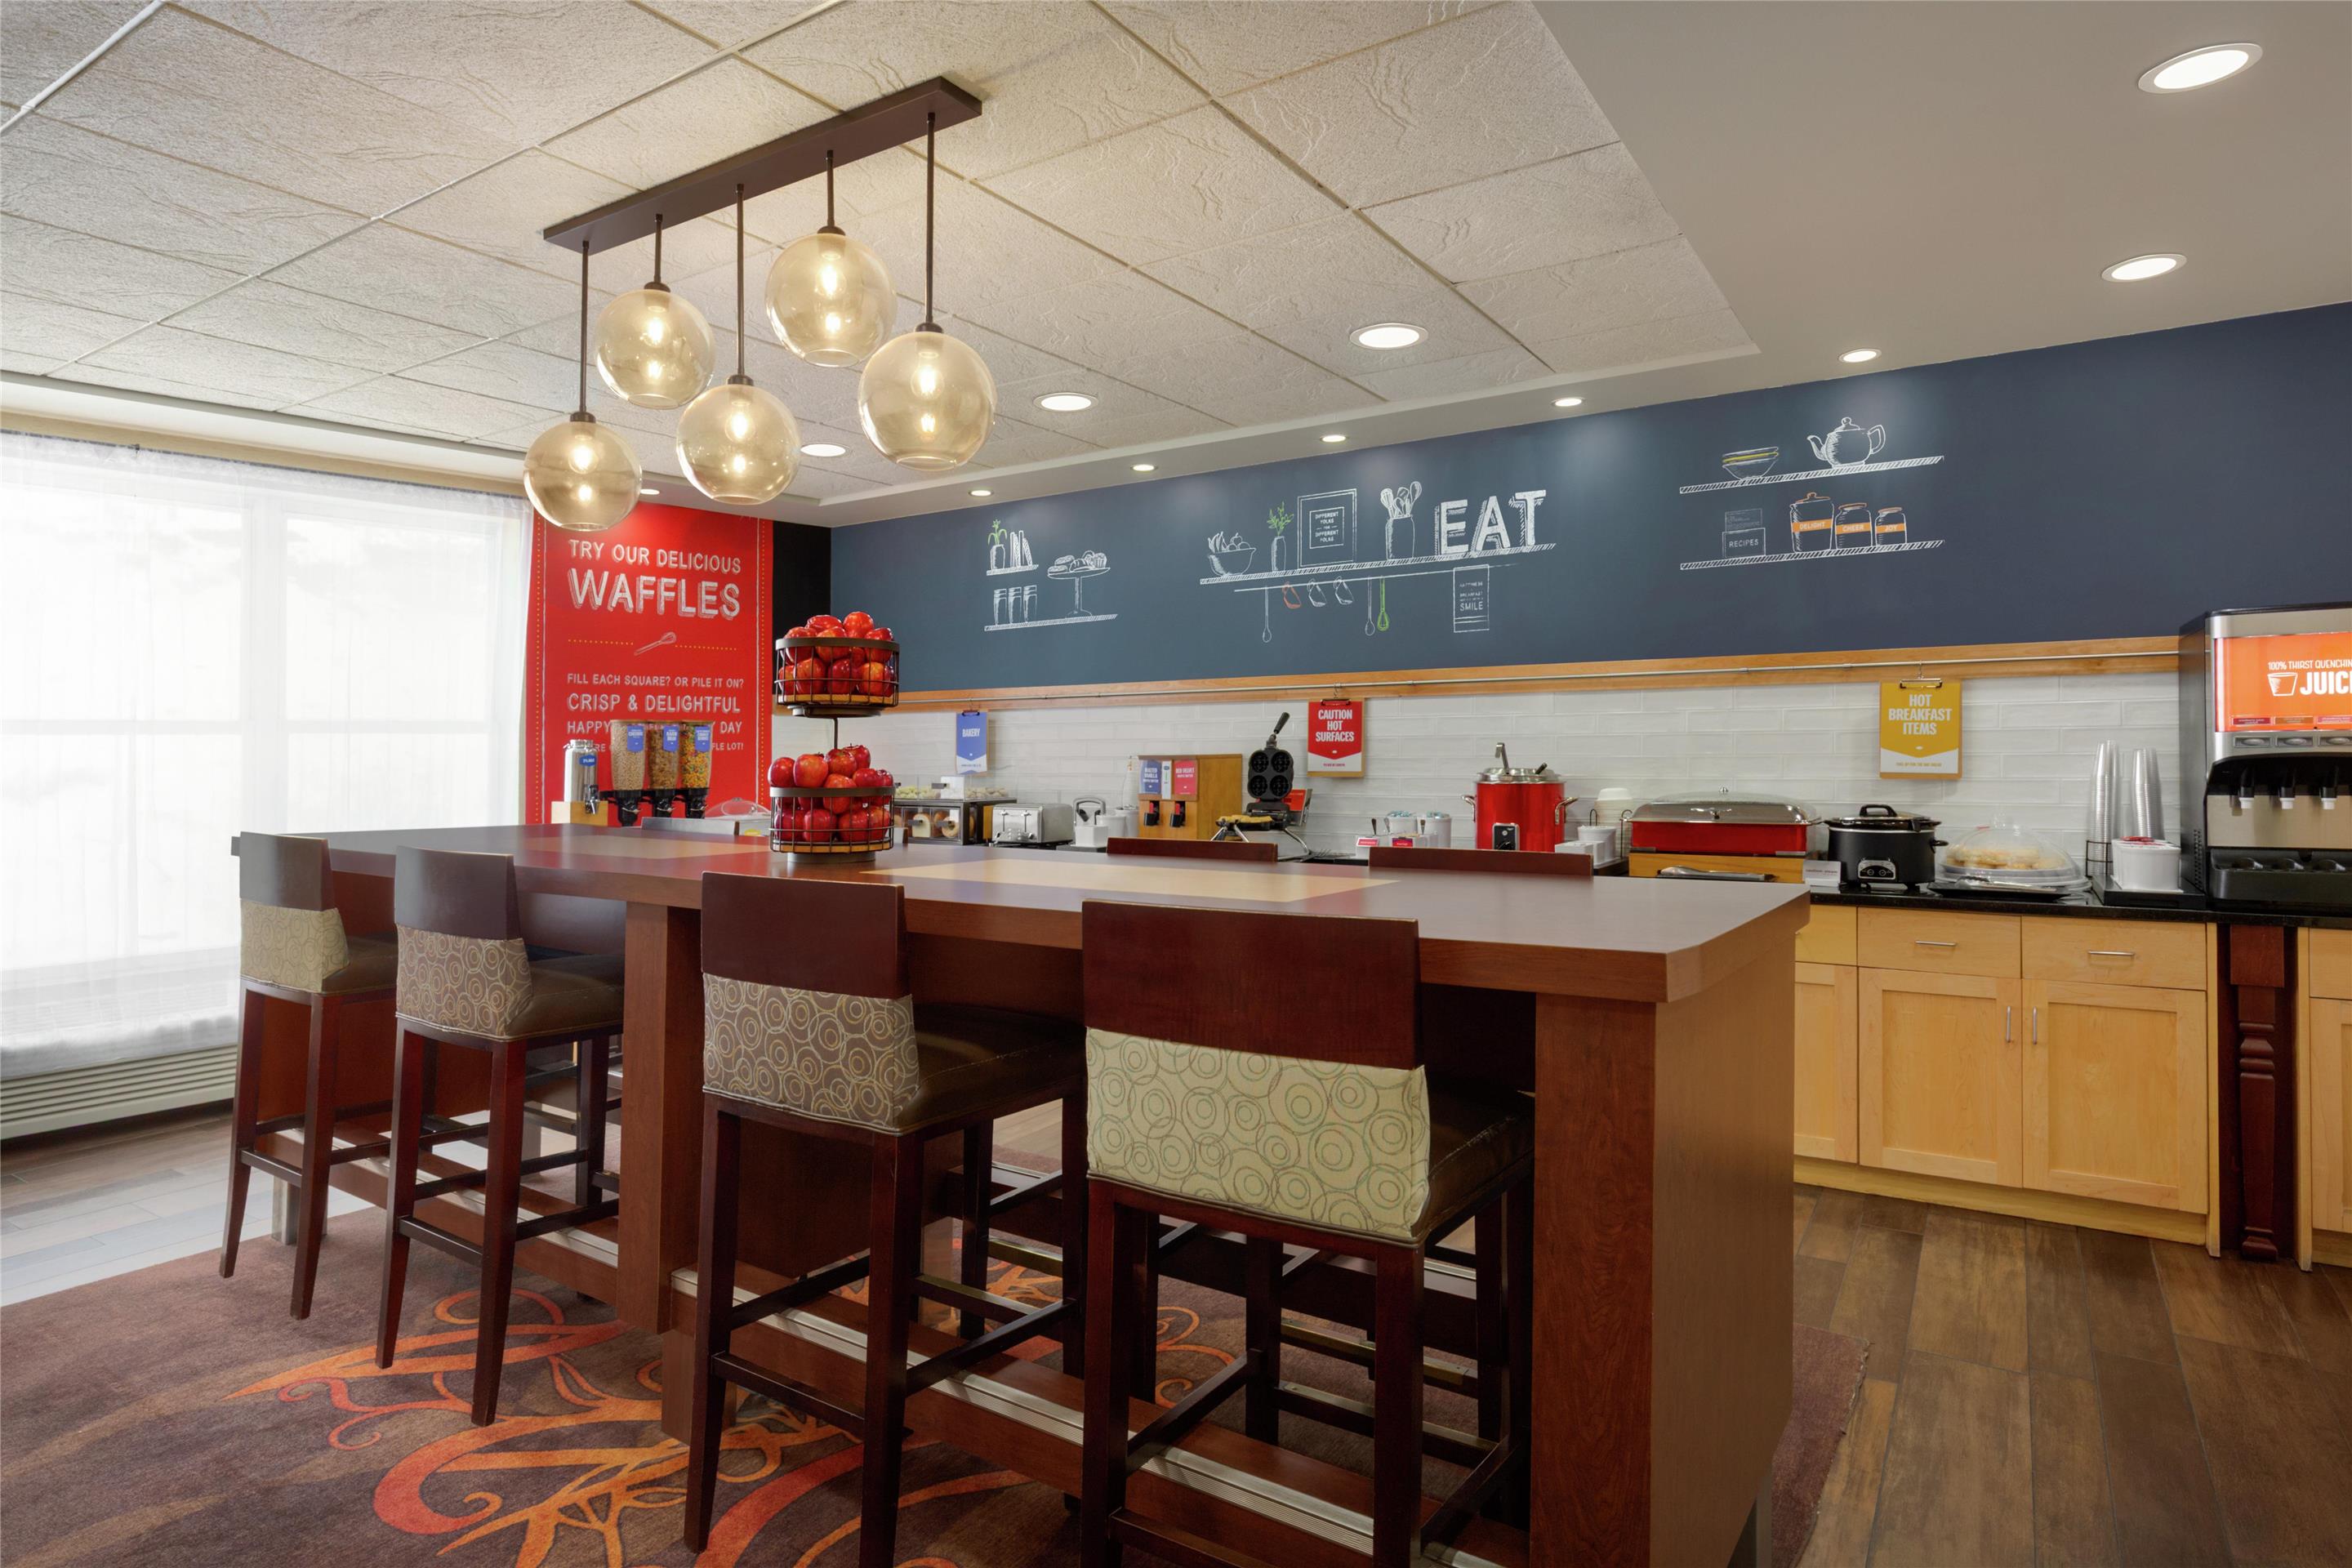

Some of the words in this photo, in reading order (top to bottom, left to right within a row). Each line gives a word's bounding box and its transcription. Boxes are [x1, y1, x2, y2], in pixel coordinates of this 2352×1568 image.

[1435, 490, 1546, 555] EAT
[1799, 522, 1825, 530] DELIGHT
[1729, 539, 1759, 548] RECIPES
[568, 539, 604, 560] TRY
[612, 544, 650, 566] OUR
[656, 549, 742, 574] DELICIOUS
[568, 568, 740, 621] WAFFLES
[1459, 601, 1484, 611] SMILE
[2268, 661, 2287, 670] 100%
[2288, 660, 2313, 669] THIRST
[568, 673, 588, 684] FILL
[593, 674, 621, 685] EACH
[624, 675, 671, 686] SQUARE?
[675, 676, 688, 687] OR
[692, 677, 711, 688] PILE
[715, 678, 723, 688] IT
[726, 678, 744, 688] ON?
[2300, 670, 2352, 695] JUIC
[568, 693, 621, 712] CRISP
[627, 694, 638, 712] &
[645, 694, 741, 714] DELIGHTFUL
[1909, 694, 1932, 706] HOT
[1318, 709, 1353, 719] CAUTION
[1888, 708, 1952, 720] BREAKFAST
[567, 720, 611, 734] HAPPY
[720, 721, 742, 734] DAY
[1327, 720, 1343, 731] HOT
[1903, 722, 1937, 735] ITEMS
[962, 728, 981, 737] BAKERY
[1316, 732, 1355, 742] SURFACES
[727, 742, 744, 751] LOT!
